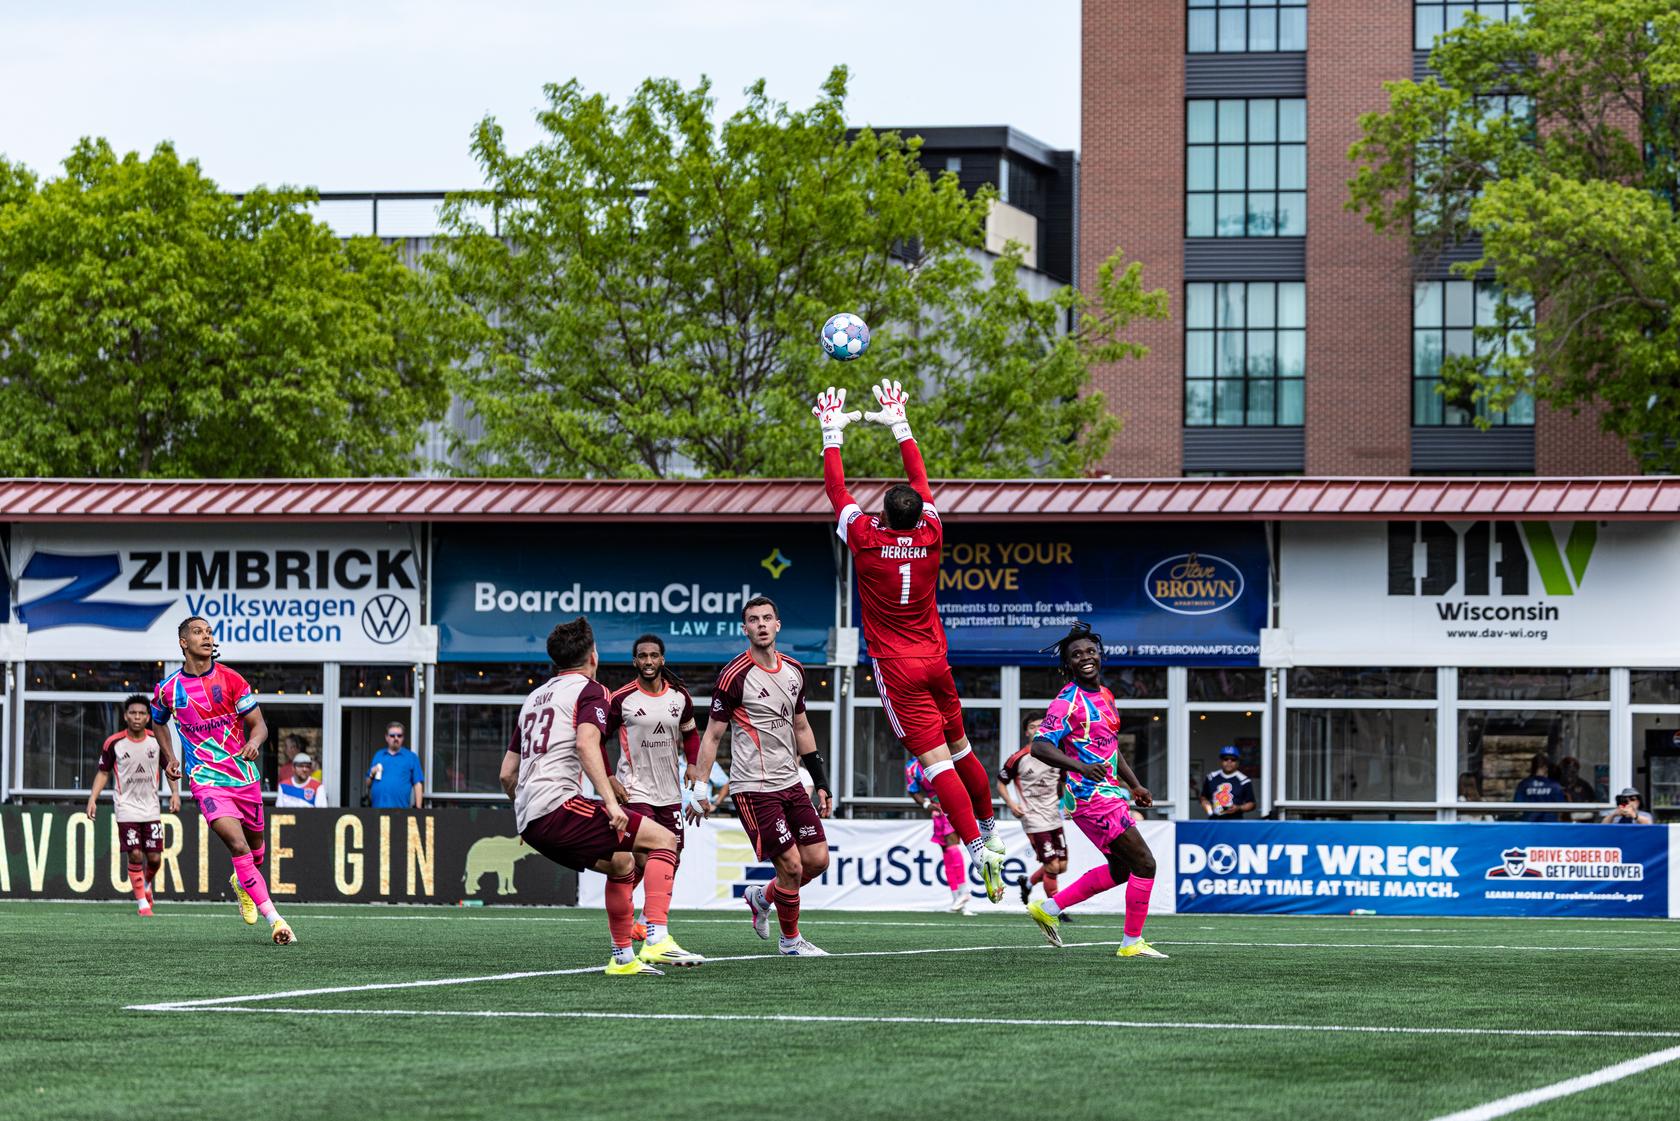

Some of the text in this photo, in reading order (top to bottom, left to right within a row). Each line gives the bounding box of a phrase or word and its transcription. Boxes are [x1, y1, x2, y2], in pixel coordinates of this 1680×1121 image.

[881, 545, 928, 559] HERRERA
[940, 543, 1073, 565] FOR YOUR
[1388, 520, 1598, 596] DAV
[128, 549, 416, 591] ZIMBRICK
[1170, 552, 1217, 580] Steve
[898, 563, 911, 605] 1
[939, 568, 1020, 591] MOVE
[1155, 580, 1236, 598] BROWN
[185, 593, 355, 623] Volkswagen
[475, 582, 762, 614] BoardmanClark
[988, 604, 1000, 613] to
[1002, 604, 1033, 613] room
[1035, 601, 1053, 613] for
[1055, 601, 1093, 613] what's
[1436, 601, 1560, 621] Wisconsin
[671, 621, 748, 637] LAW FIR
[945, 615, 1006, 629] apartment
[1007, 615, 1041, 629] living
[1447, 628, 1549, 641] www.dav-wi.org
[533, 691, 554, 707] SILVA
[522, 707, 555, 760] 33
[0, 811, 435, 896] VOURIE GIN
[1316, 845, 1460, 877] WRECK
[1530, 850, 1620, 863] DRIVE SOBER OR
[1546, 865, 1641, 878] GET PULLED OVER
[1179, 879, 1460, 898] A GREAT TIME AT THE MATCH.
[1485, 890, 1515, 899] LEARN
[1516, 891, 1543, 900] MORE
[1544, 891, 1555, 900] AT
